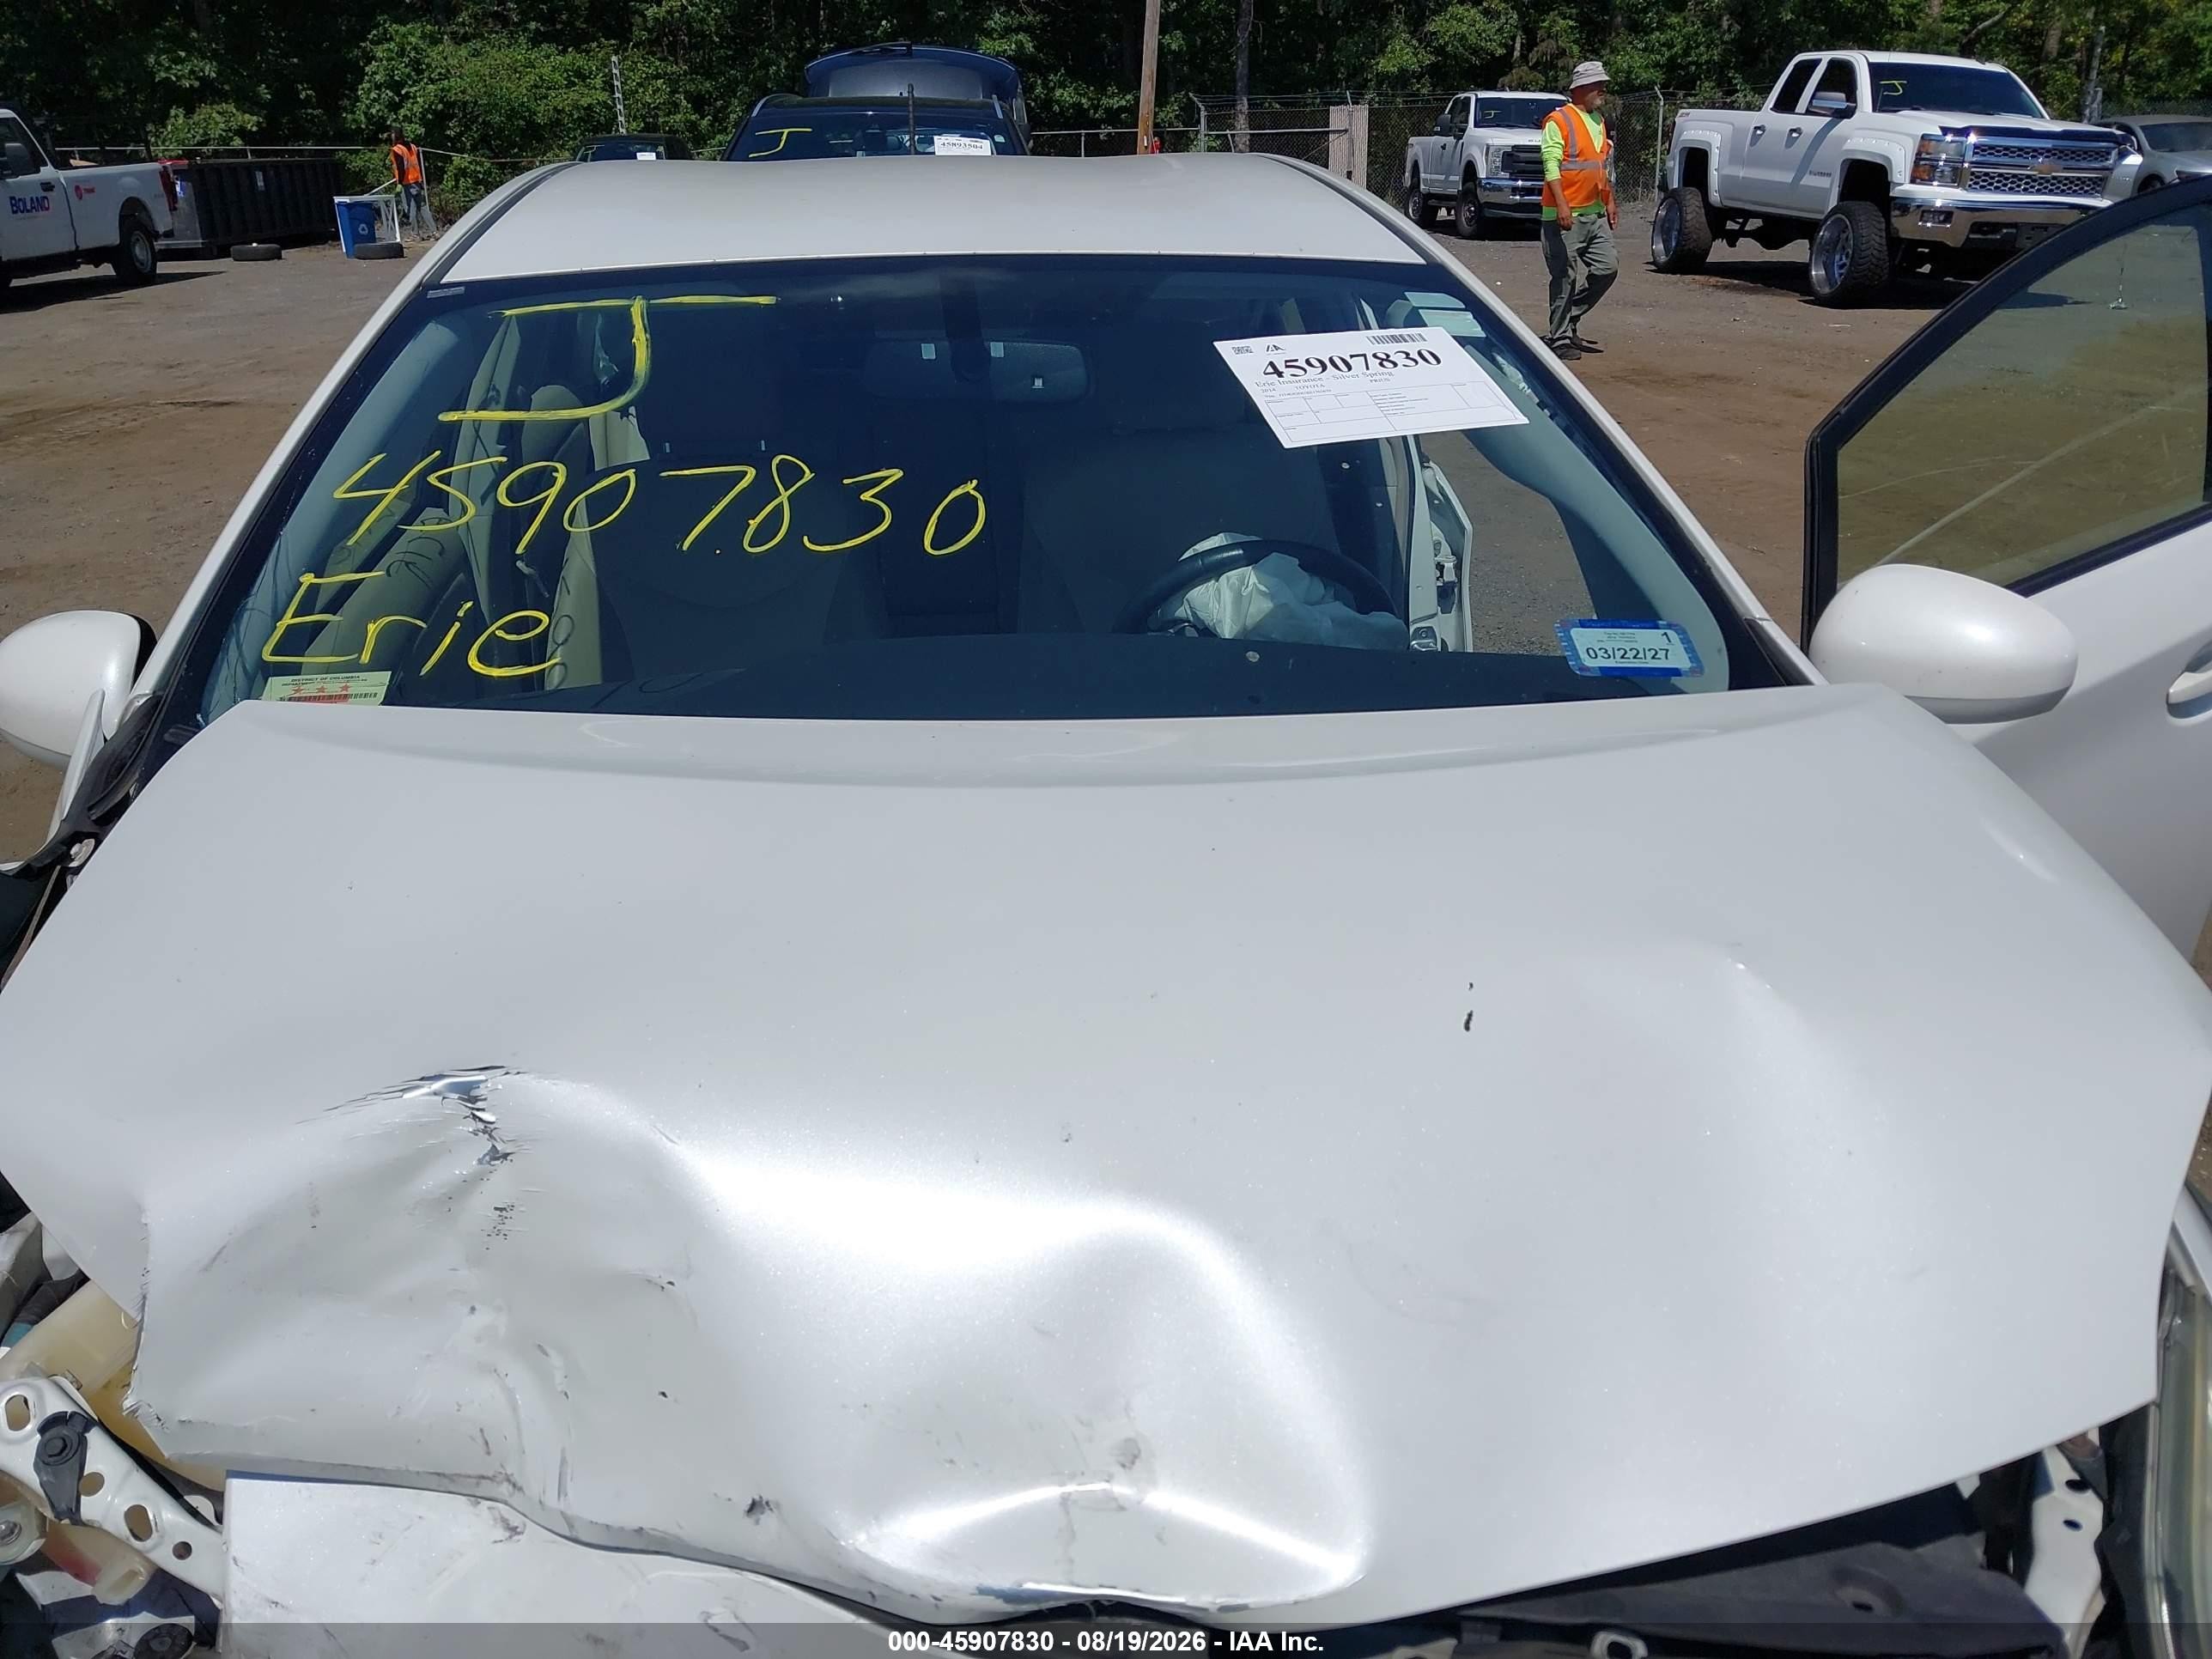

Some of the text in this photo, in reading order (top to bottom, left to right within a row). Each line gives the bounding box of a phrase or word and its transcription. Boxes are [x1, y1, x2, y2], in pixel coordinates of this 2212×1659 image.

[748, 128, 812, 158] J
[436, 295, 779, 422] J
[1263, 349, 1442, 379] 45907830
[1278, 377, 1323, 386] Insurance
[261, 570, 561, 677] Erie
[1661, 631, 1672, 643] 1
[1586, 647, 1669, 660] 03/22/27
